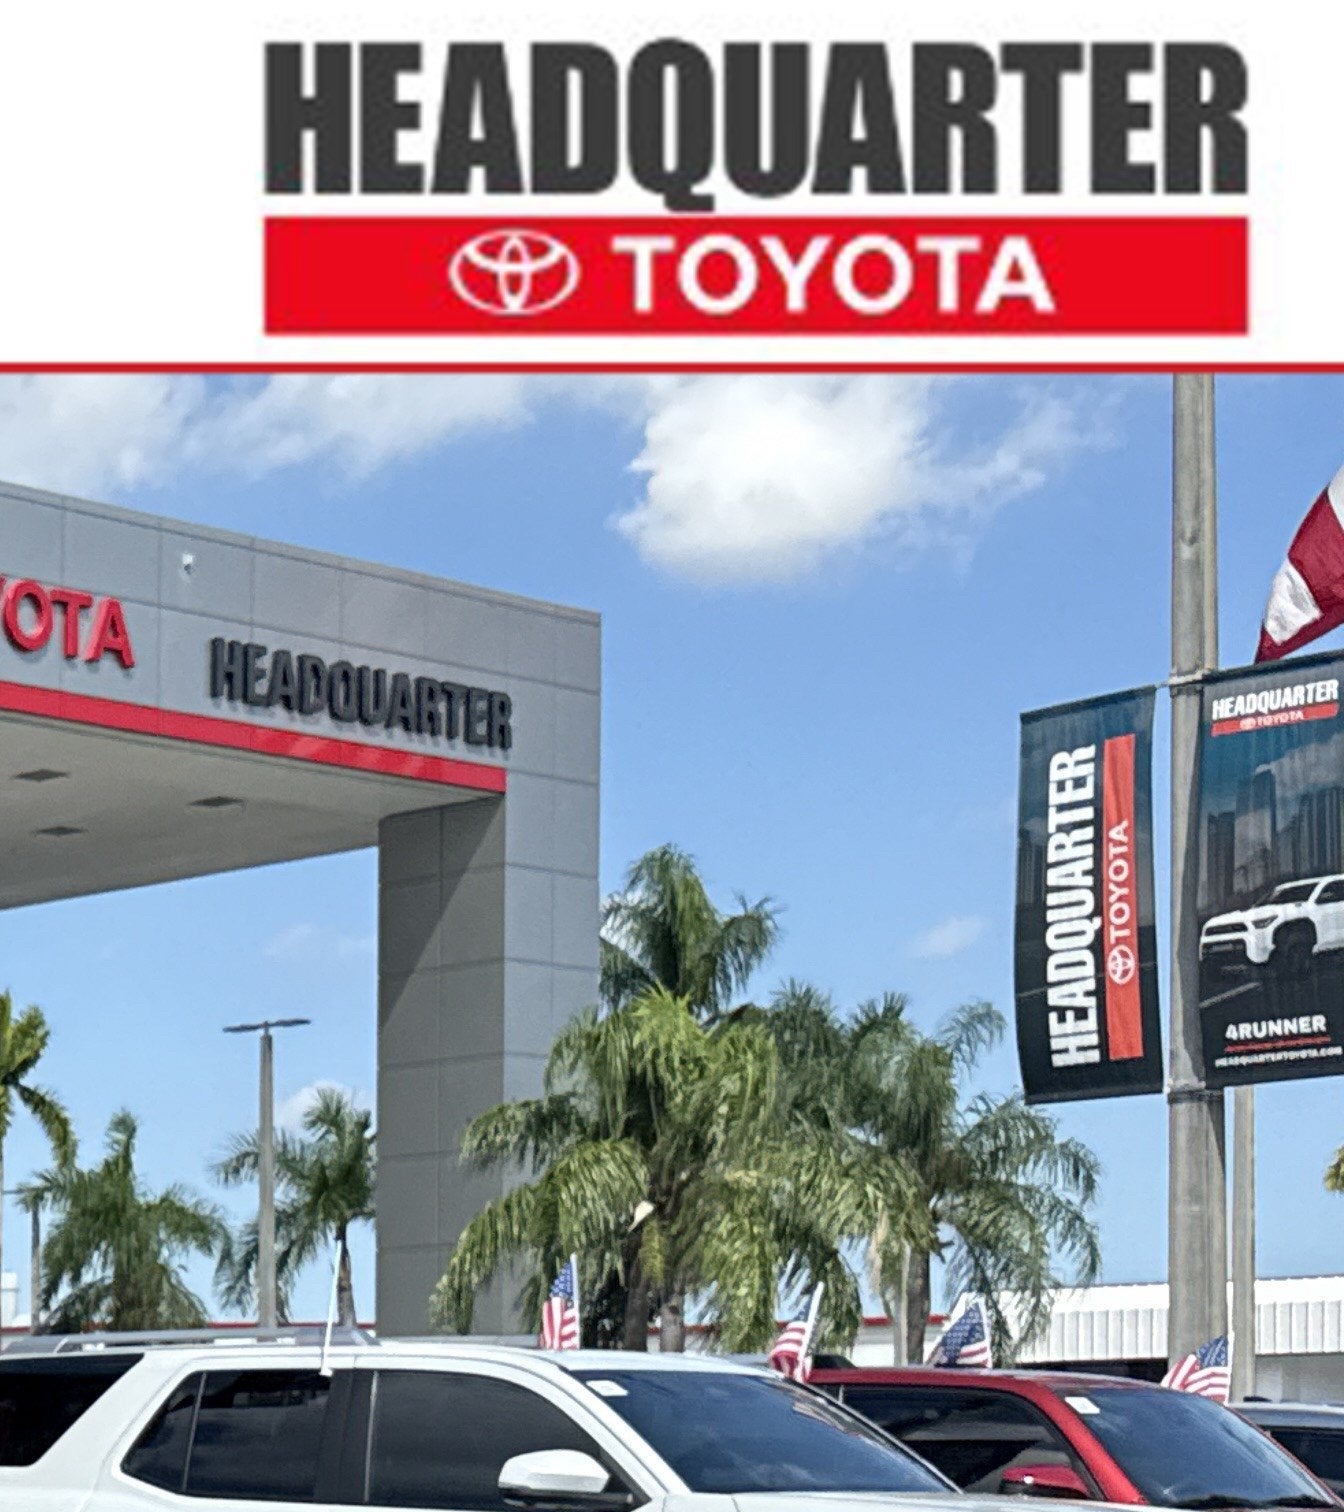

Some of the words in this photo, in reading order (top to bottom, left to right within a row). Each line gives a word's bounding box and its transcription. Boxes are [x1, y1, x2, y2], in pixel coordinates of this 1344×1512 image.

[209, 636, 514, 750] HEADQUARTER
[1211, 678, 1340, 721] HEADQUARTER
[1044, 743, 1102, 1068] HEADQUARTER
[1108, 818, 1130, 944] TOYOTA
[1224, 1014, 1327, 1041] 4RUNNER
